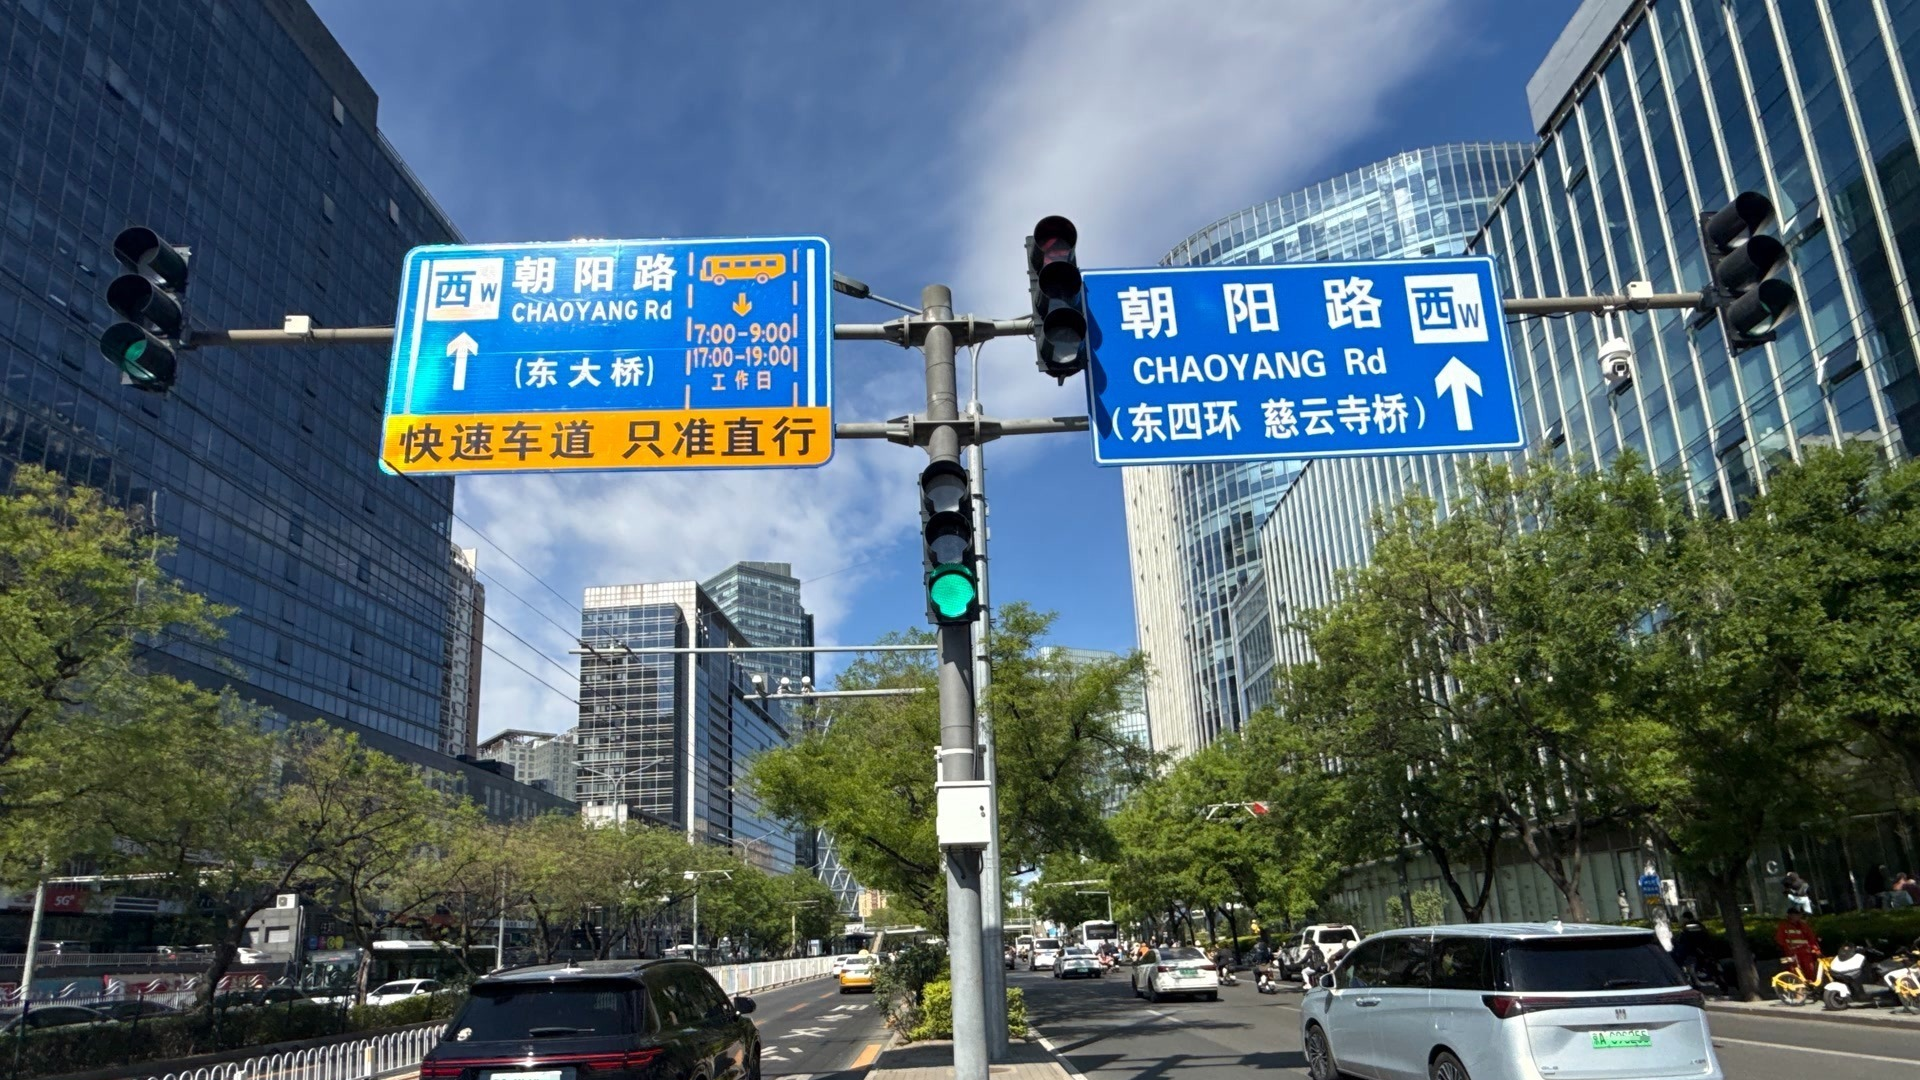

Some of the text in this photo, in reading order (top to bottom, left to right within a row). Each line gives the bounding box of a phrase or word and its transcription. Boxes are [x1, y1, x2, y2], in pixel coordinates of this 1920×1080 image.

[434, 270, 497, 308] 西 W
[512, 253, 678, 293] 朝阳路
[512, 299, 672, 323] CHAOYANG Rd
[1118, 275, 1382, 340] 朝阳路
[1411, 286, 1479, 331] 西 W
[695, 323, 790, 344] 7:00-9:00
[515, 356, 654, 389] (东大桥)
[692, 345, 791, 368] 17:00-19:00
[1133, 347, 1387, 385] CHAOYANG Rd
[711, 370, 772, 391] 工作日
[400, 416, 816, 463] 快速车道 只准直行
